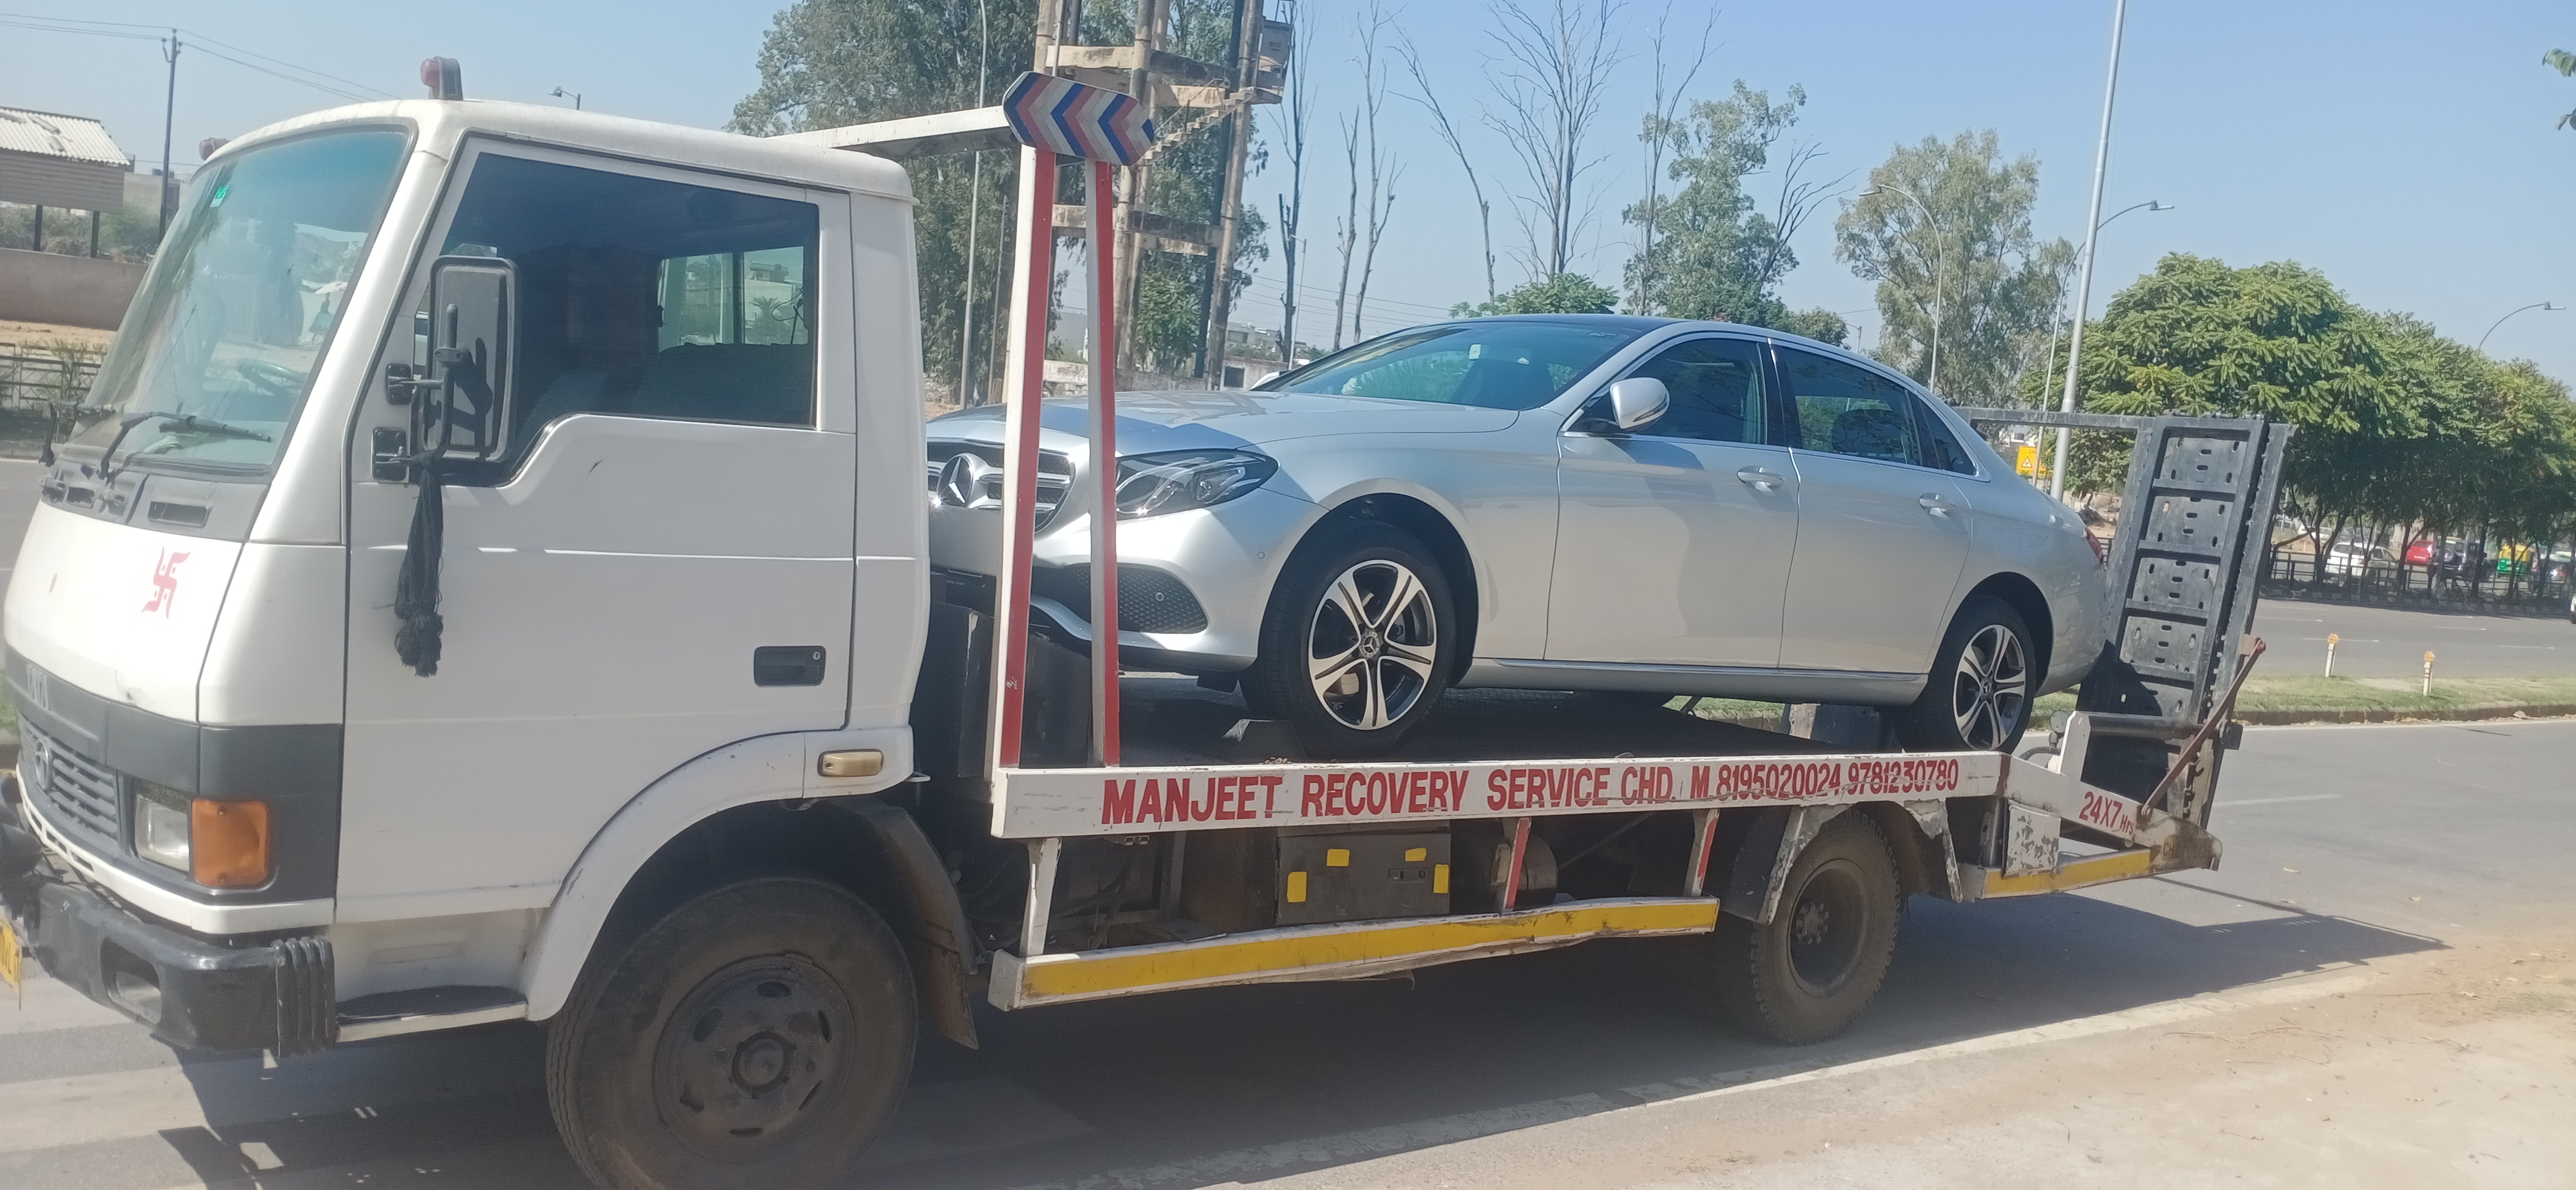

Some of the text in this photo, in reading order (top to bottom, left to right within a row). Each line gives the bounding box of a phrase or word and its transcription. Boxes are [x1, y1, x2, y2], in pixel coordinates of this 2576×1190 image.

[1101, 776, 1283, 825] MANJEET
[1301, 770, 1470, 817] RECOVERY
[1486, 768, 1610, 811] SERVICE
[1621, 766, 1676, 806] CHD.
[2078, 791, 2135, 836] 24X7 Hrs
